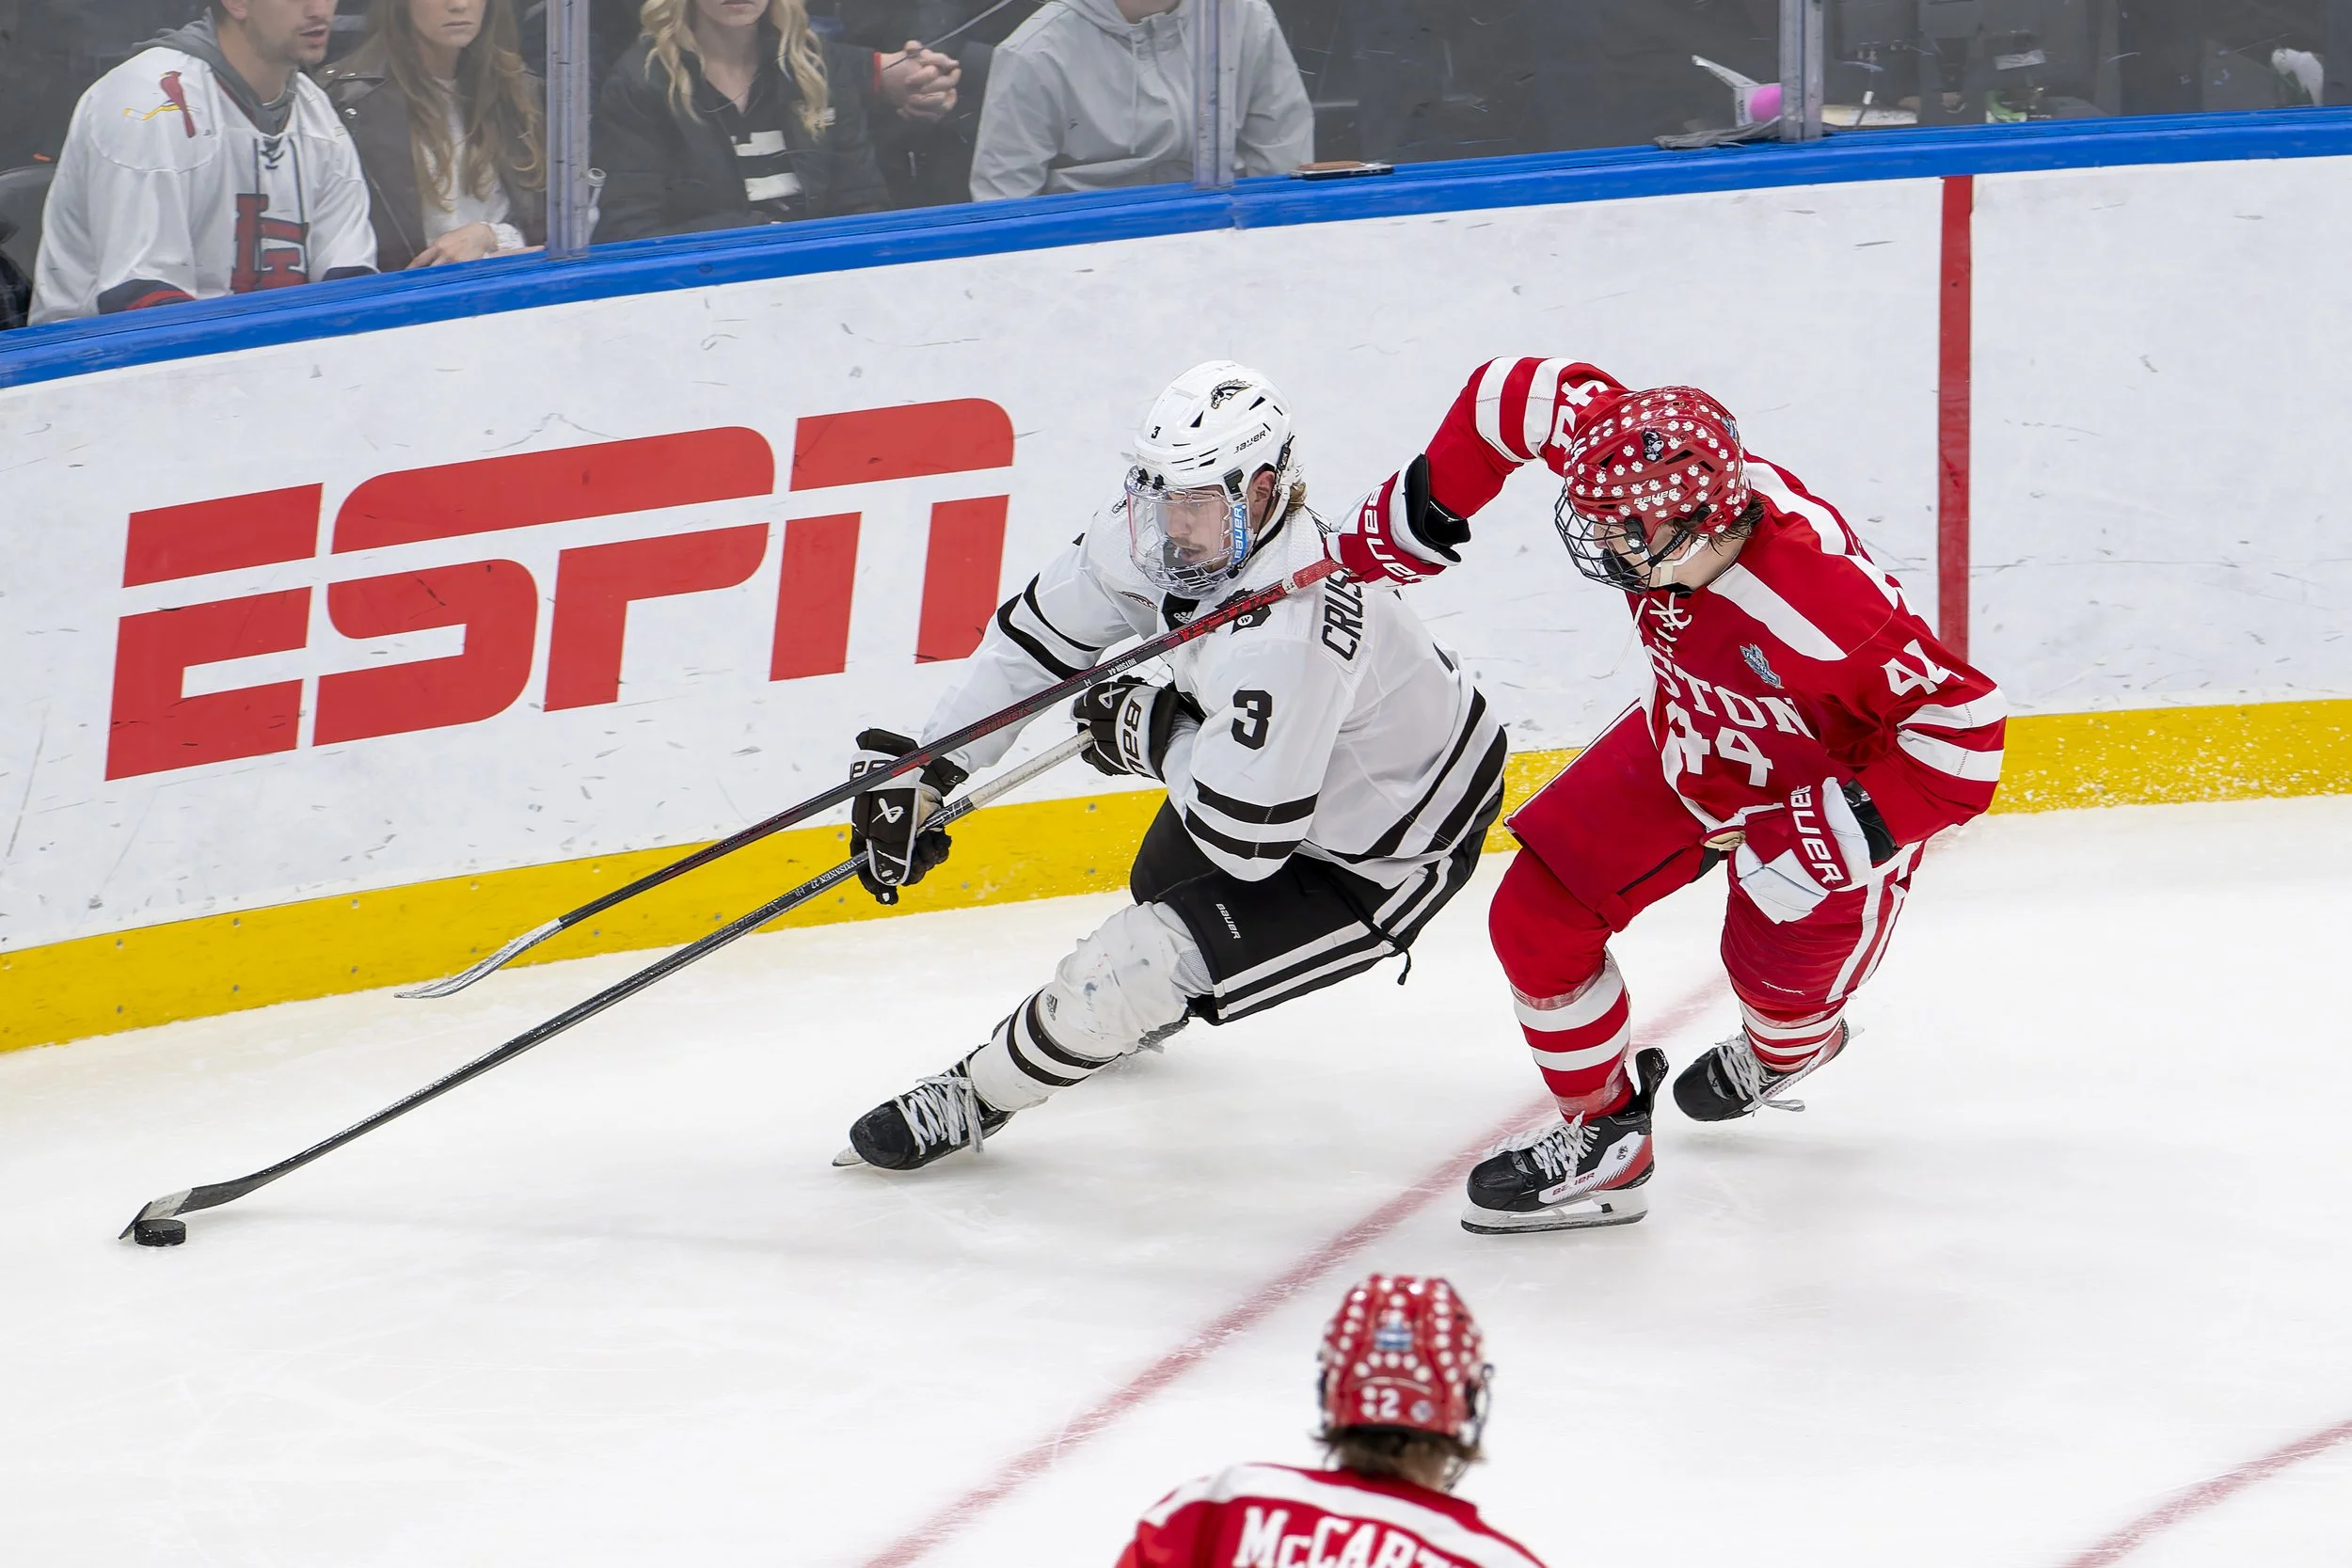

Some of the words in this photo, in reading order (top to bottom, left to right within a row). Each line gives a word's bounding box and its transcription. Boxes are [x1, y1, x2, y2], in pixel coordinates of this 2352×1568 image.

[1151, 425, 1161, 439] 3
[104, 397, 1014, 782] ESPN
[1321, 567, 1363, 661] CRUS
[1645, 644, 1818, 741] STON
[1880, 639, 1964, 697] 44
[1232, 689, 1273, 751] 3
[1664, 699, 1774, 787] 44
[1216, 903, 1243, 940] BAUER
[1232, 1506, 1460, 1568] McCAR
